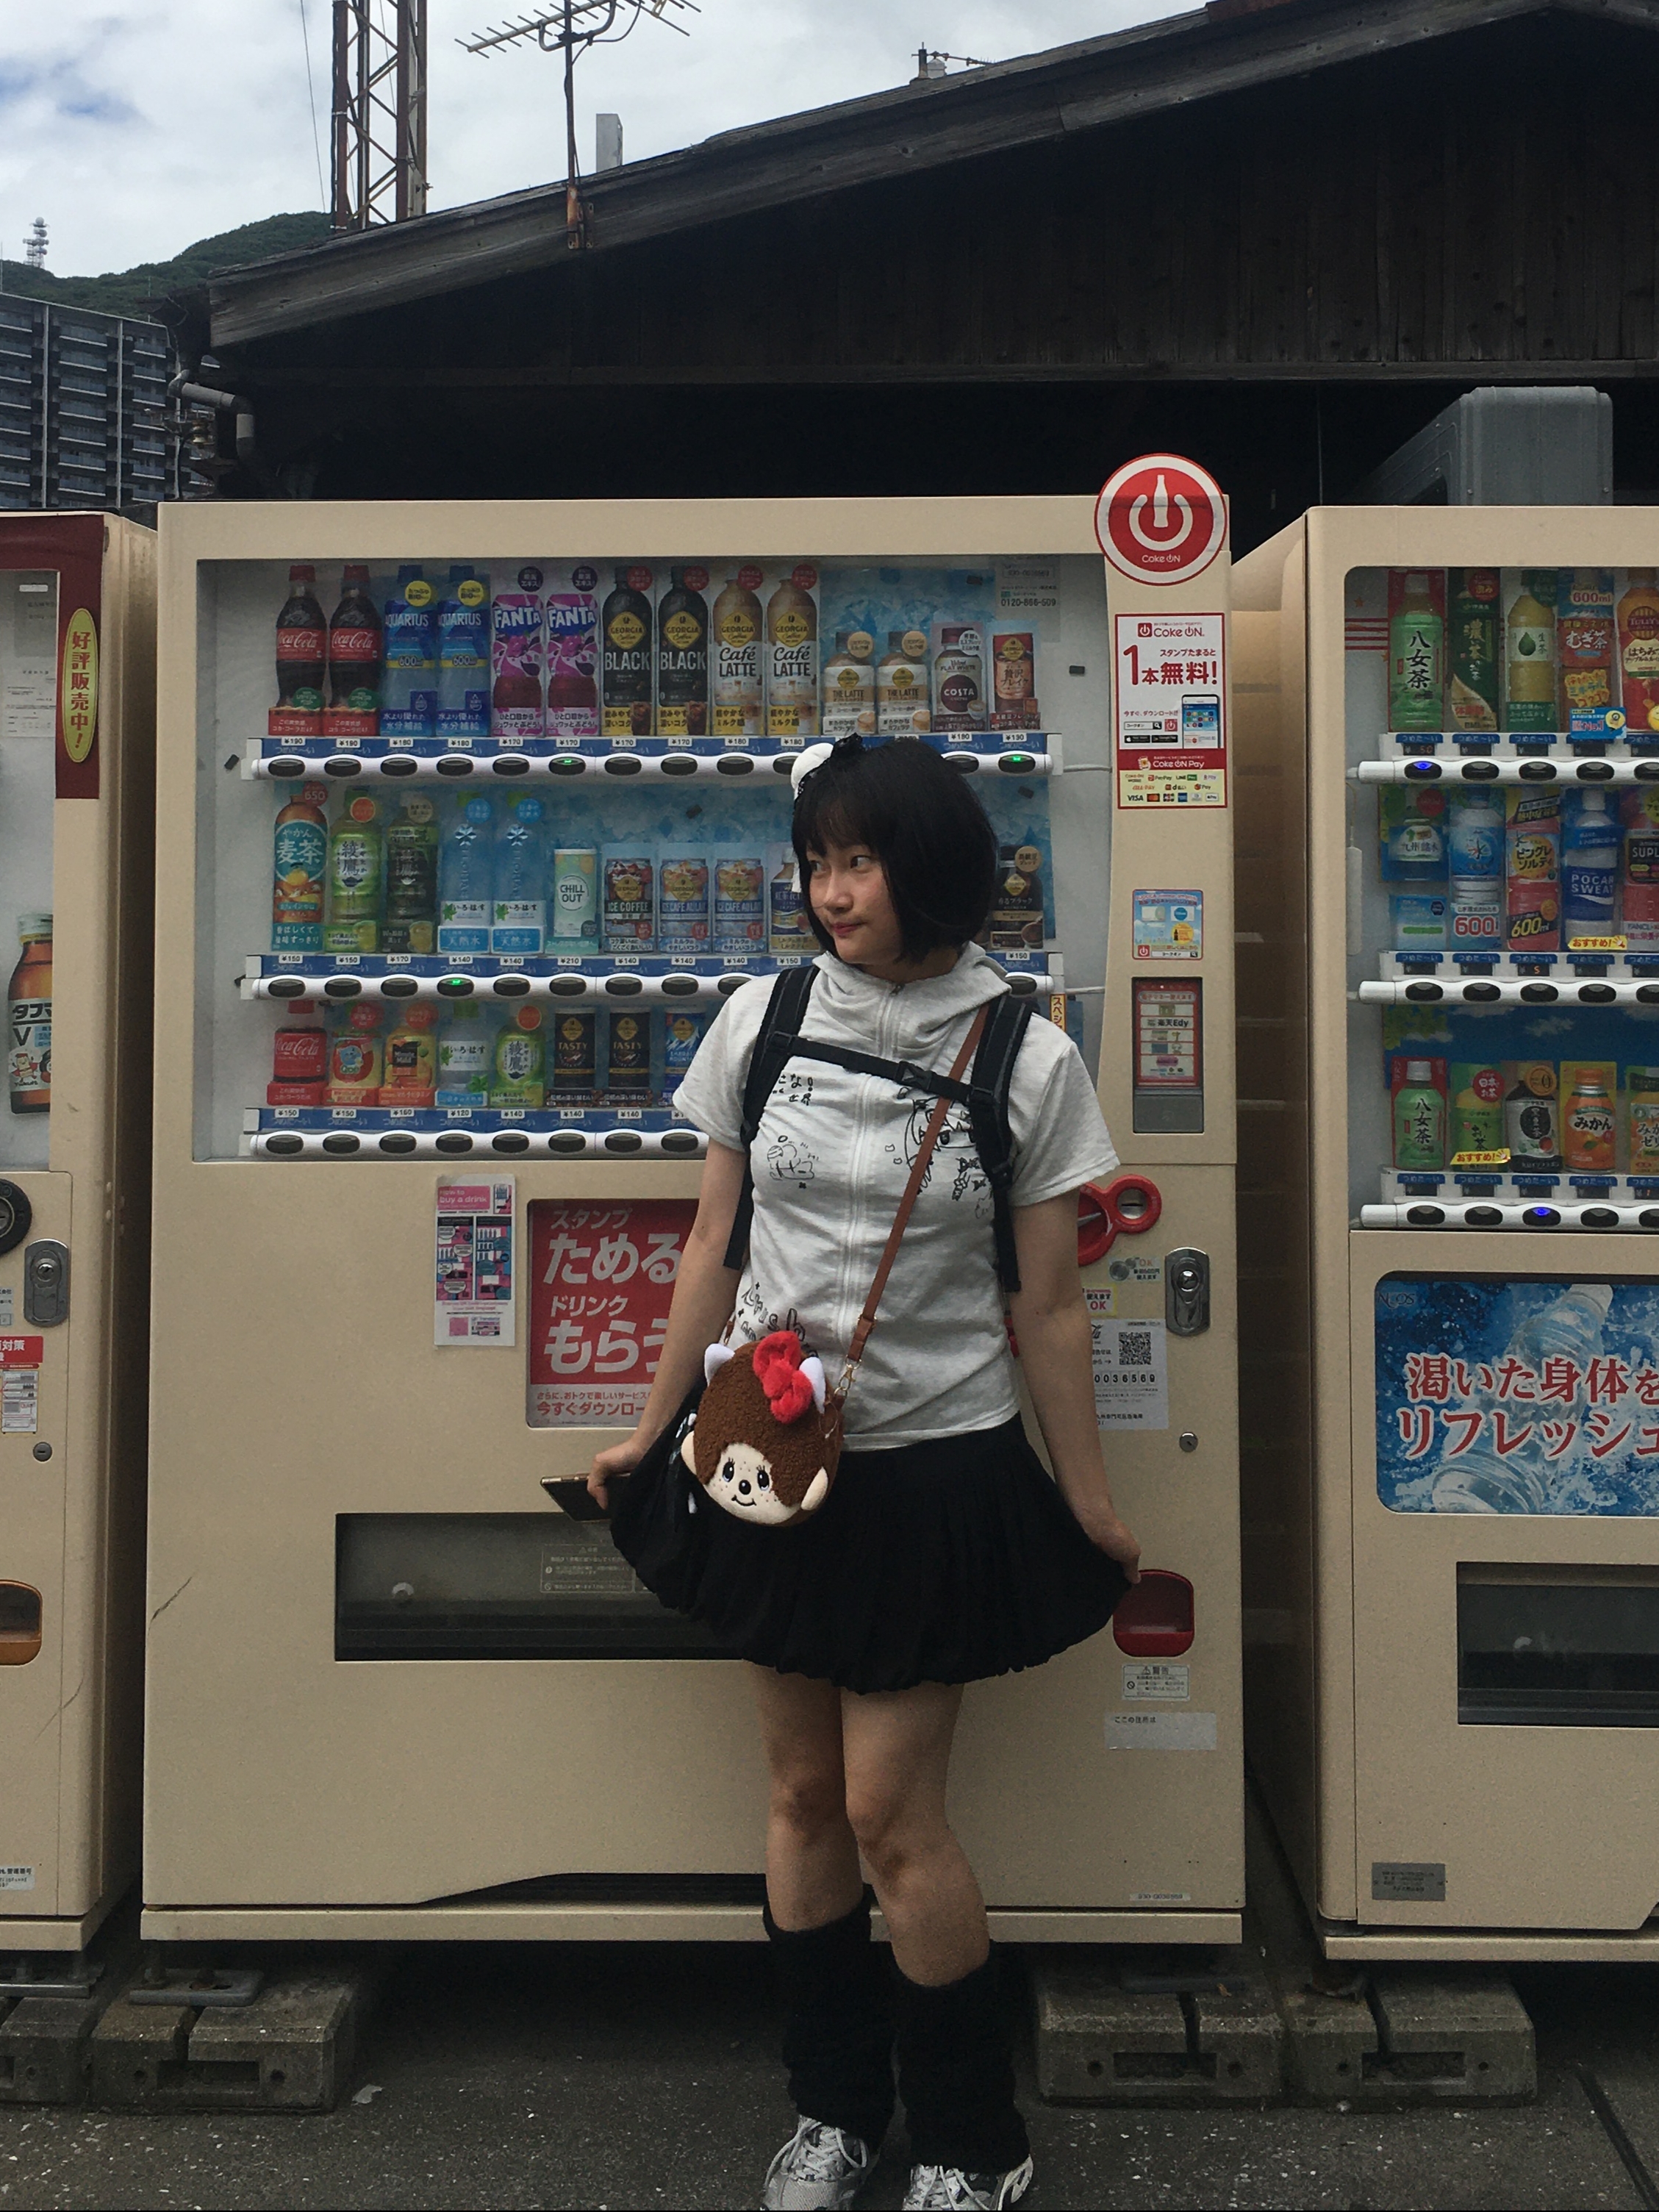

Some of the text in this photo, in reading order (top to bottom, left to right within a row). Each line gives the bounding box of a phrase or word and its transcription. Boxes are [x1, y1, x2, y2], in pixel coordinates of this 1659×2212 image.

[1142, 554, 1181, 563] Coke ON
[494, 607, 543, 629] FANTA
[548, 607, 597, 629] FANTA
[610, 626, 643, 634] GEORGIA
[666, 626, 698, 634] GEORGIA
[721, 625, 754, 634] GEORGIA
[775, 625, 809, 634] GEORGIA
[1154, 626, 1203, 637] Coke ON
[1566, 629, 1608, 649] むぎ茶
[720, 646, 756, 662] Café
[773, 646, 810, 662] Café
[1160, 648, 1217, 657] スタンプたまると
[604, 651, 650, 670] BLACK
[660, 651, 706, 670] BLACK
[1405, 630, 1433, 689] 八女茶
[719, 662, 757, 677] LATTE
[773, 662, 811, 677] LATTE
[71, 631, 92, 749] 好評販売中!
[944, 688, 975, 696] COSTA
[1153, 760, 1205, 770] Coke ON Pay
[304, 791, 326, 801] 650
[282, 828, 313, 838] やかん
[276, 838, 324, 865] 麦茶
[341, 841, 359, 876] 綾鷹
[560, 884, 585, 893] CHILL
[562, 894, 583, 903] OUT
[608, 902, 648, 912] ICE COFFEE
[276, 926, 315, 934] 香ばしくて
[1455, 916, 1494, 936] 600
[1572, 938, 1612, 948] おすすめ!
[1157, 1019, 1189, 1028] 楽天Edy
[12, 1026, 32, 1047] V
[558, 1042, 587, 1050] TASTY
[613, 1042, 642, 1050] TASTY
[620, 1110, 639, 1118] ¥140
[1413, 1097, 1433, 1145] 八女茶
[1574, 1117, 1613, 1131] みかん
[1456, 1153, 1496, 1163] おすすめ!
[465, 1195, 488, 1203] drink
[551, 1207, 633, 1229] スタンプ
[543, 1232, 683, 1284] ためる
[1139, 1258, 1153, 1267] OK
[551, 1295, 629, 1317] ドリンク
[1090, 1300, 1107, 1311] OK
[1094, 1374, 1156, 1384] 0036569
[1407, 1355, 1659, 1406] 渇いた身体を
[537, 1391, 651, 1400] さらに、おトクで楽しいサービス
[1114, 1716, 1157, 1724] ここの住所は
